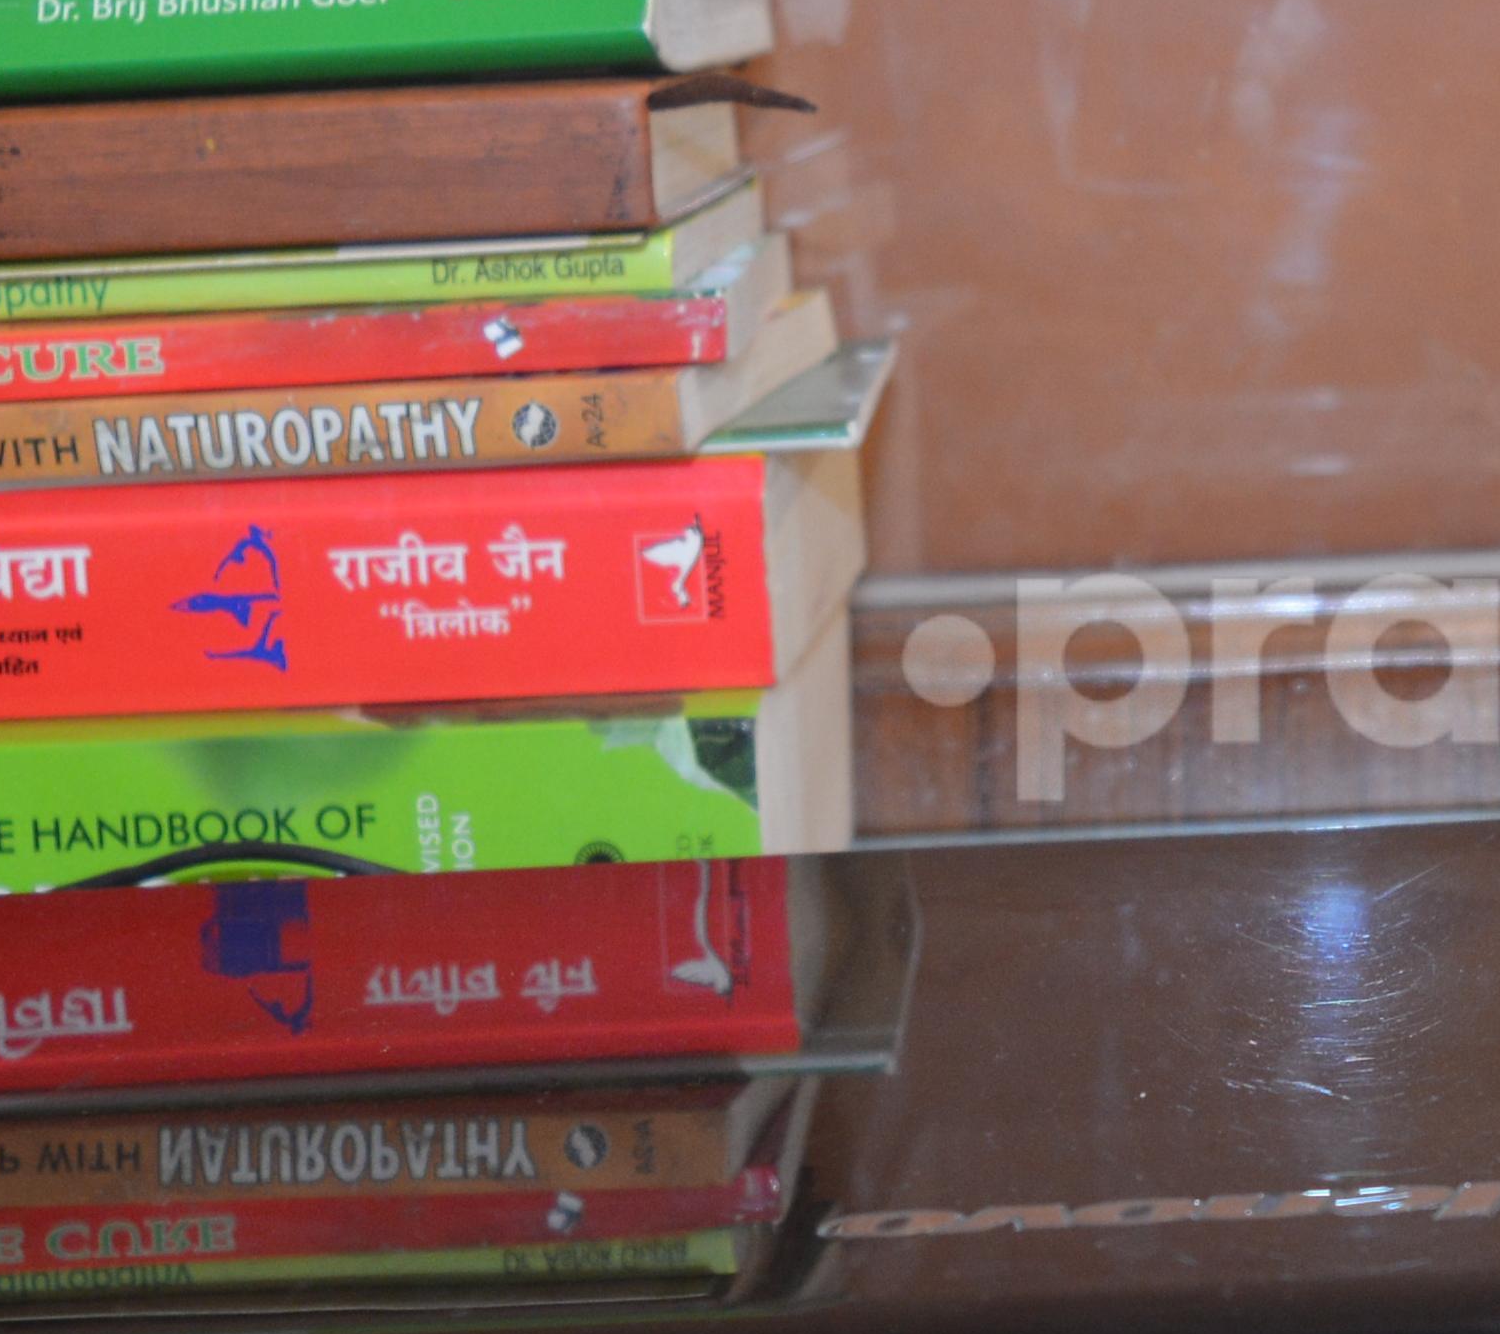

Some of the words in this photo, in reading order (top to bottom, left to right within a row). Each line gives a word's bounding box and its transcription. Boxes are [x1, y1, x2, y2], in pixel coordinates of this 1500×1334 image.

[431, 258, 466, 285] Dr.
[475, 253, 547, 283] Ashok
[554, 253, 626, 283] Gupta
[92, 397, 482, 475] NATUROPATHY
[328, 530, 468, 594] राजीव
[487, 523, 568, 581] जैन
[32, 807, 307, 854] HANDBOOK
[314, 804, 377, 842] OF
[416, 793, 442, 874] VISED
